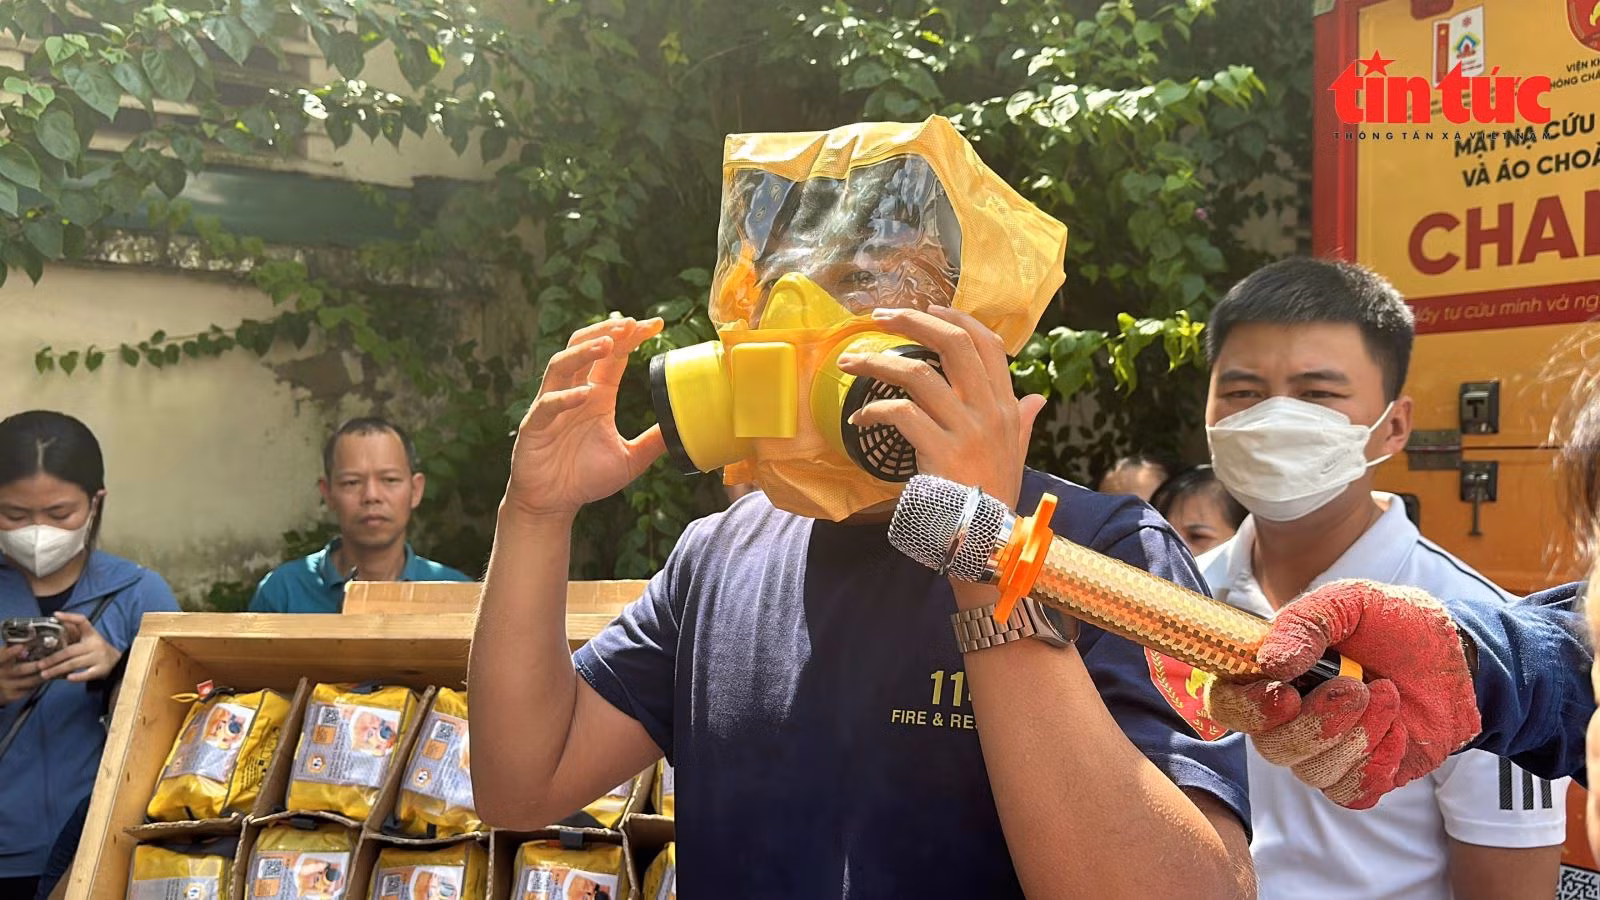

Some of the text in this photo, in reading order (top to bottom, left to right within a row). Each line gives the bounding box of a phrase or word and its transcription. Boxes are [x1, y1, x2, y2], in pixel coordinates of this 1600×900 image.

[1545, 112, 1596, 140] CỨU
[1462, 162, 1490, 187] VÀ
[1496, 158, 1530, 183] ÁO
[1547, 293, 1569, 312] và
[1574, 293, 1600, 313] ng
[930, 670, 971, 707] 11
[891, 709, 978, 729] FIRE & RE
